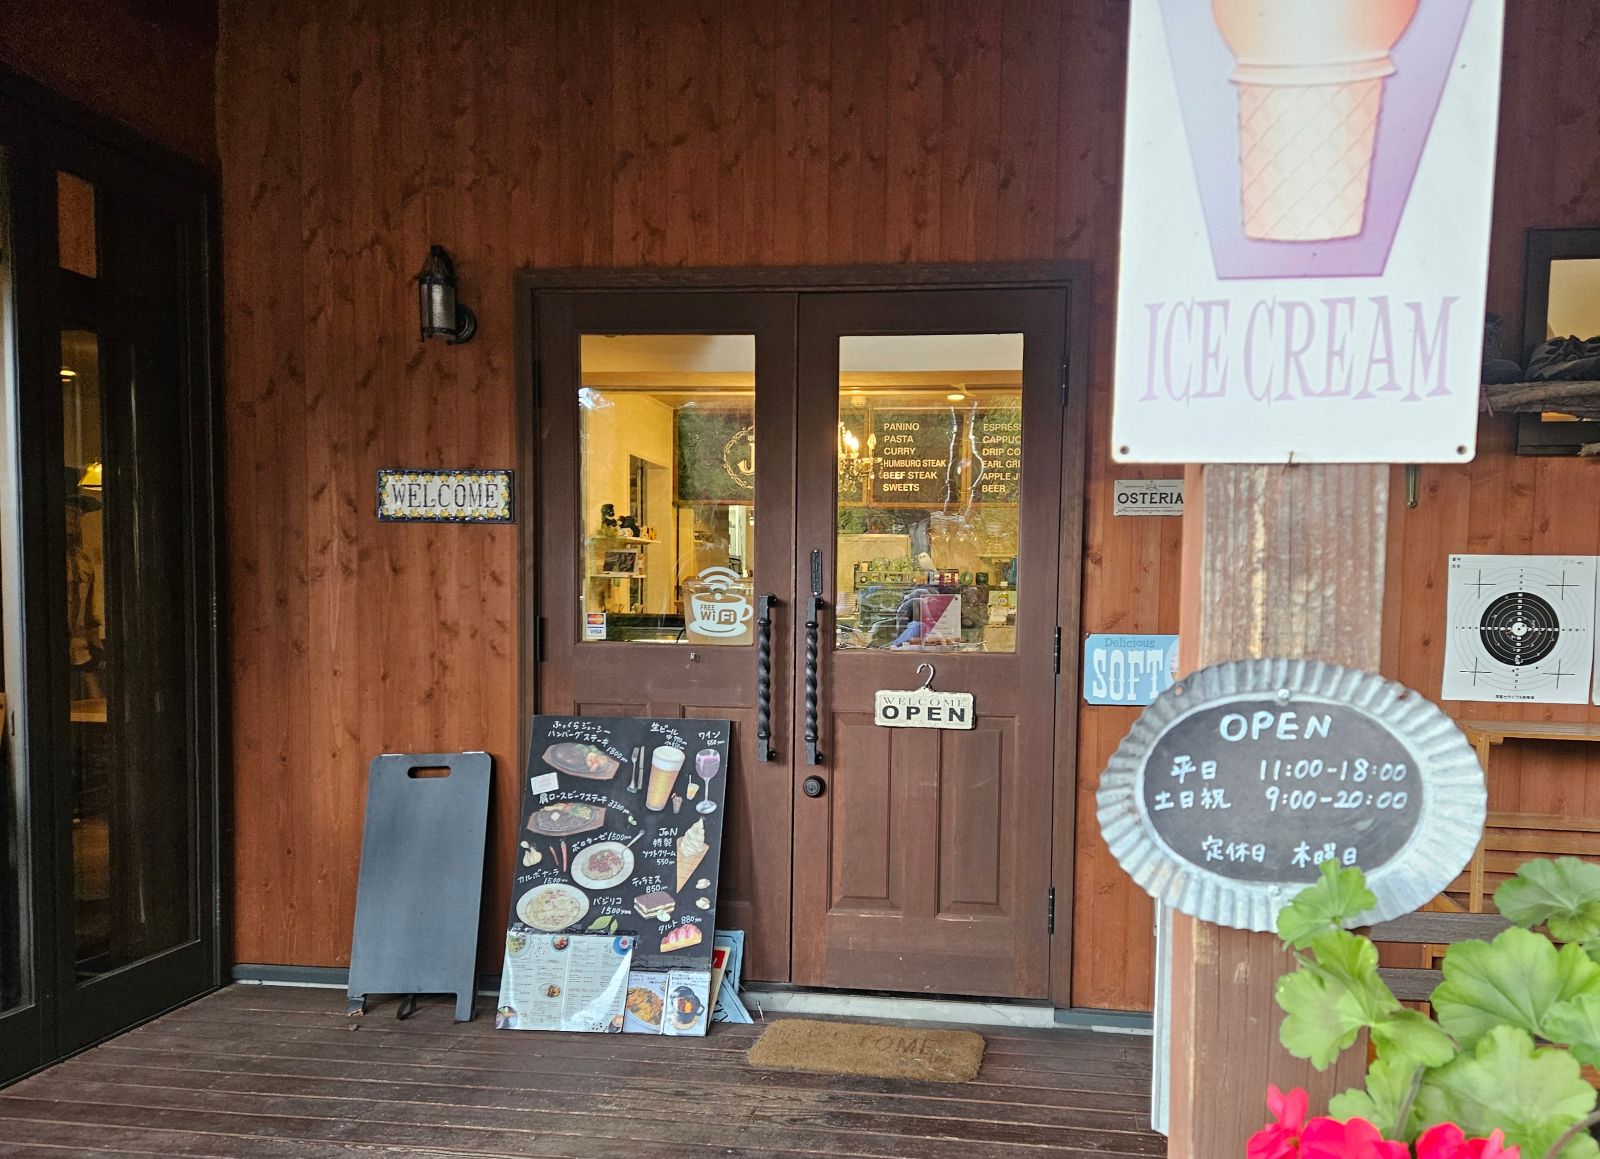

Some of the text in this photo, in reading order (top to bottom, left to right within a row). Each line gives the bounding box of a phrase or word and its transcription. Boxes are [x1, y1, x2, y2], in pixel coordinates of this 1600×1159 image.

[1138, 295, 1461, 406] ICE CREAM
[884, 422, 920, 431] PANINO
[884, 435, 914, 443] PASTA
[884, 447, 916, 455] CURRY
[982, 448, 1005, 456] DRIP
[883, 459, 947, 468] HUMBURG STEAK
[982, 460, 1004, 468] EARL
[883, 471, 938, 480] BEEF STEAK
[981, 472, 1021, 481] APPLE J
[883, 483, 920, 492] SWEETS
[981, 484, 1006, 493] BEER
[391, 483, 499, 508] WELCOME
[1117, 492, 1184, 504] OSTERIA
[1105, 637, 1156, 648] Delicious
[1092, 648, 1164, 701] SOFT
[883, 696, 966, 706] WELCOME
[882, 705, 965, 722] OPEN
[1219, 710, 1332, 742] OPEN
[547, 730, 609, 747] ハンバーグステーキ
[698, 730, 721, 740] ワイン
[1170, 754, 1407, 783] 平日 11:00-18:00
[539, 790, 608, 805] 肩ロースビーフステーキ
[1154, 783, 1408, 812] 土日祝 9:00-20:00
[571, 832, 608, 853] ボロネーゼ
[1201, 835, 1357, 868] 定休日 木曜日
[517, 868, 560, 884] カルボナーラ
[631, 875, 662, 887] ティラミス
[593, 896, 623, 906] バジリコ
[658, 919, 678, 935] タルト
